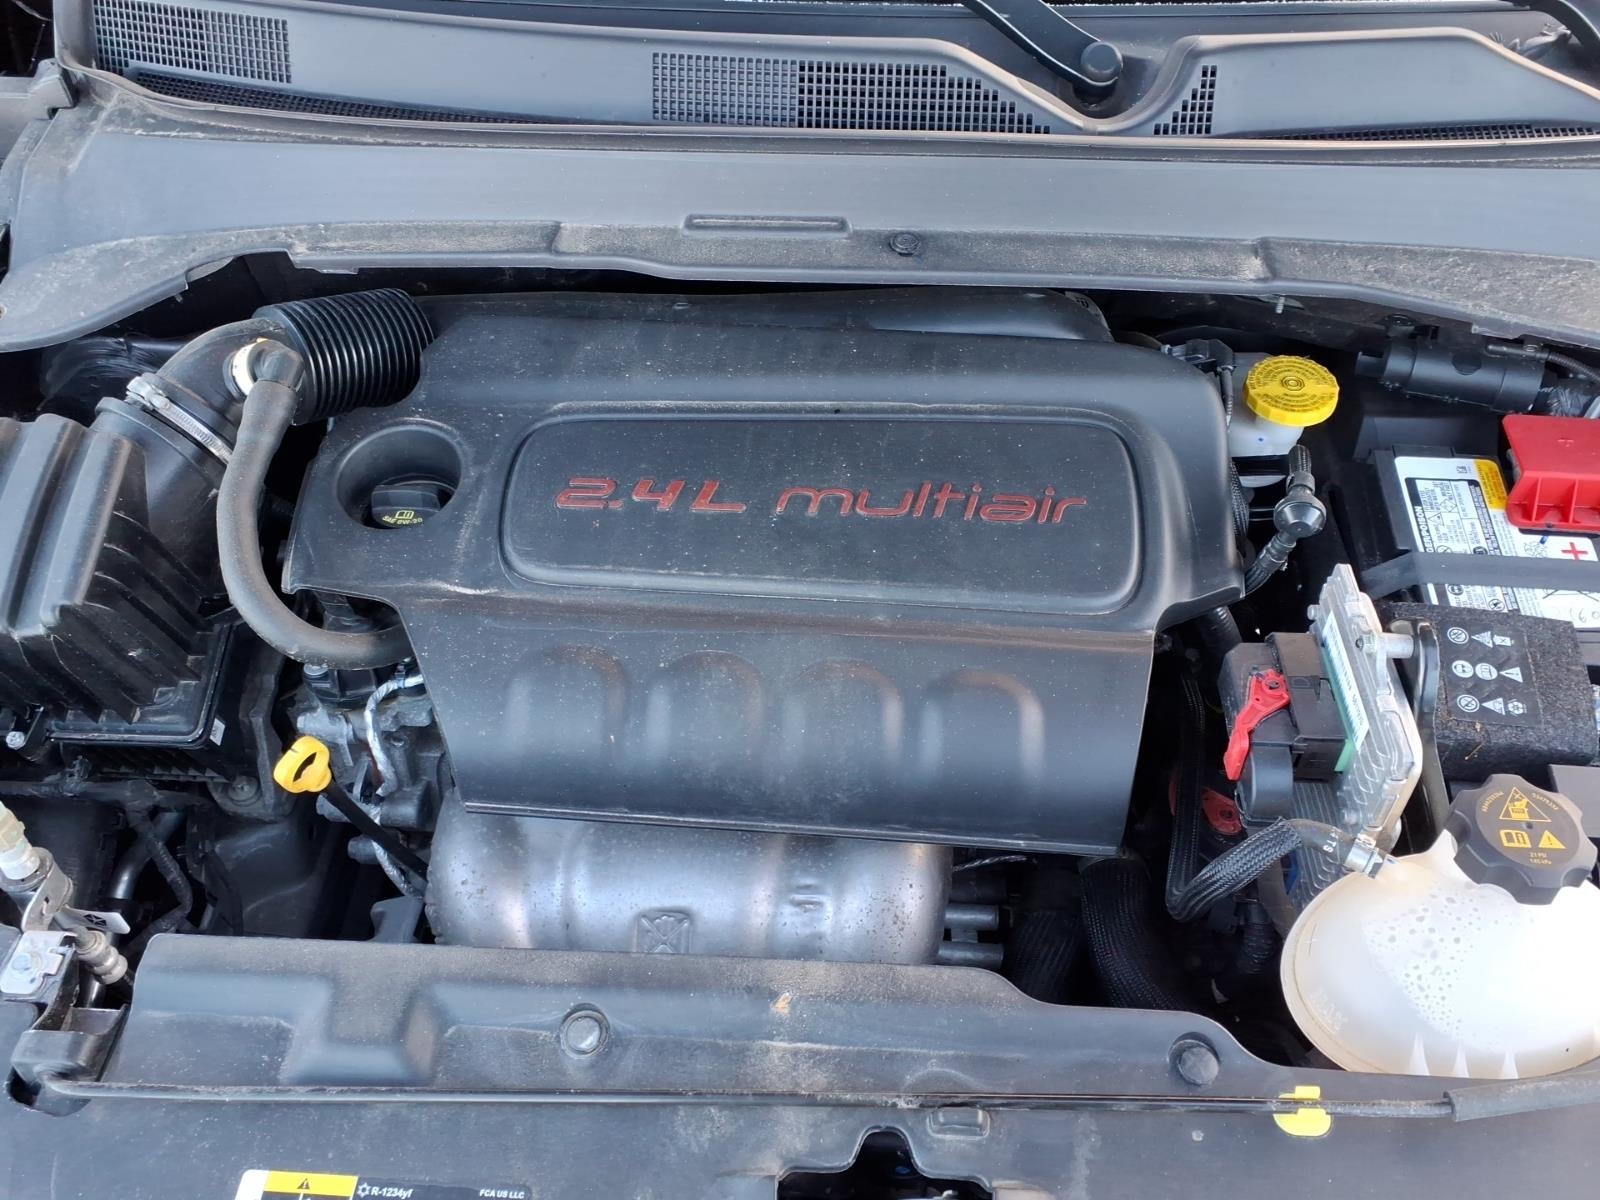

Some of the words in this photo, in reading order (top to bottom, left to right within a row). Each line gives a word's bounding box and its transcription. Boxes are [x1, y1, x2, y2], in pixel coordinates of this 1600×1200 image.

[775, 480, 1087, 524] multiair
[370, 1186, 414, 1200] R-1234yf
[479, 1188, 495, 1197] FCA
[496, 1189, 508, 1198] US
[508, 1190, 525, 1199] LLC
